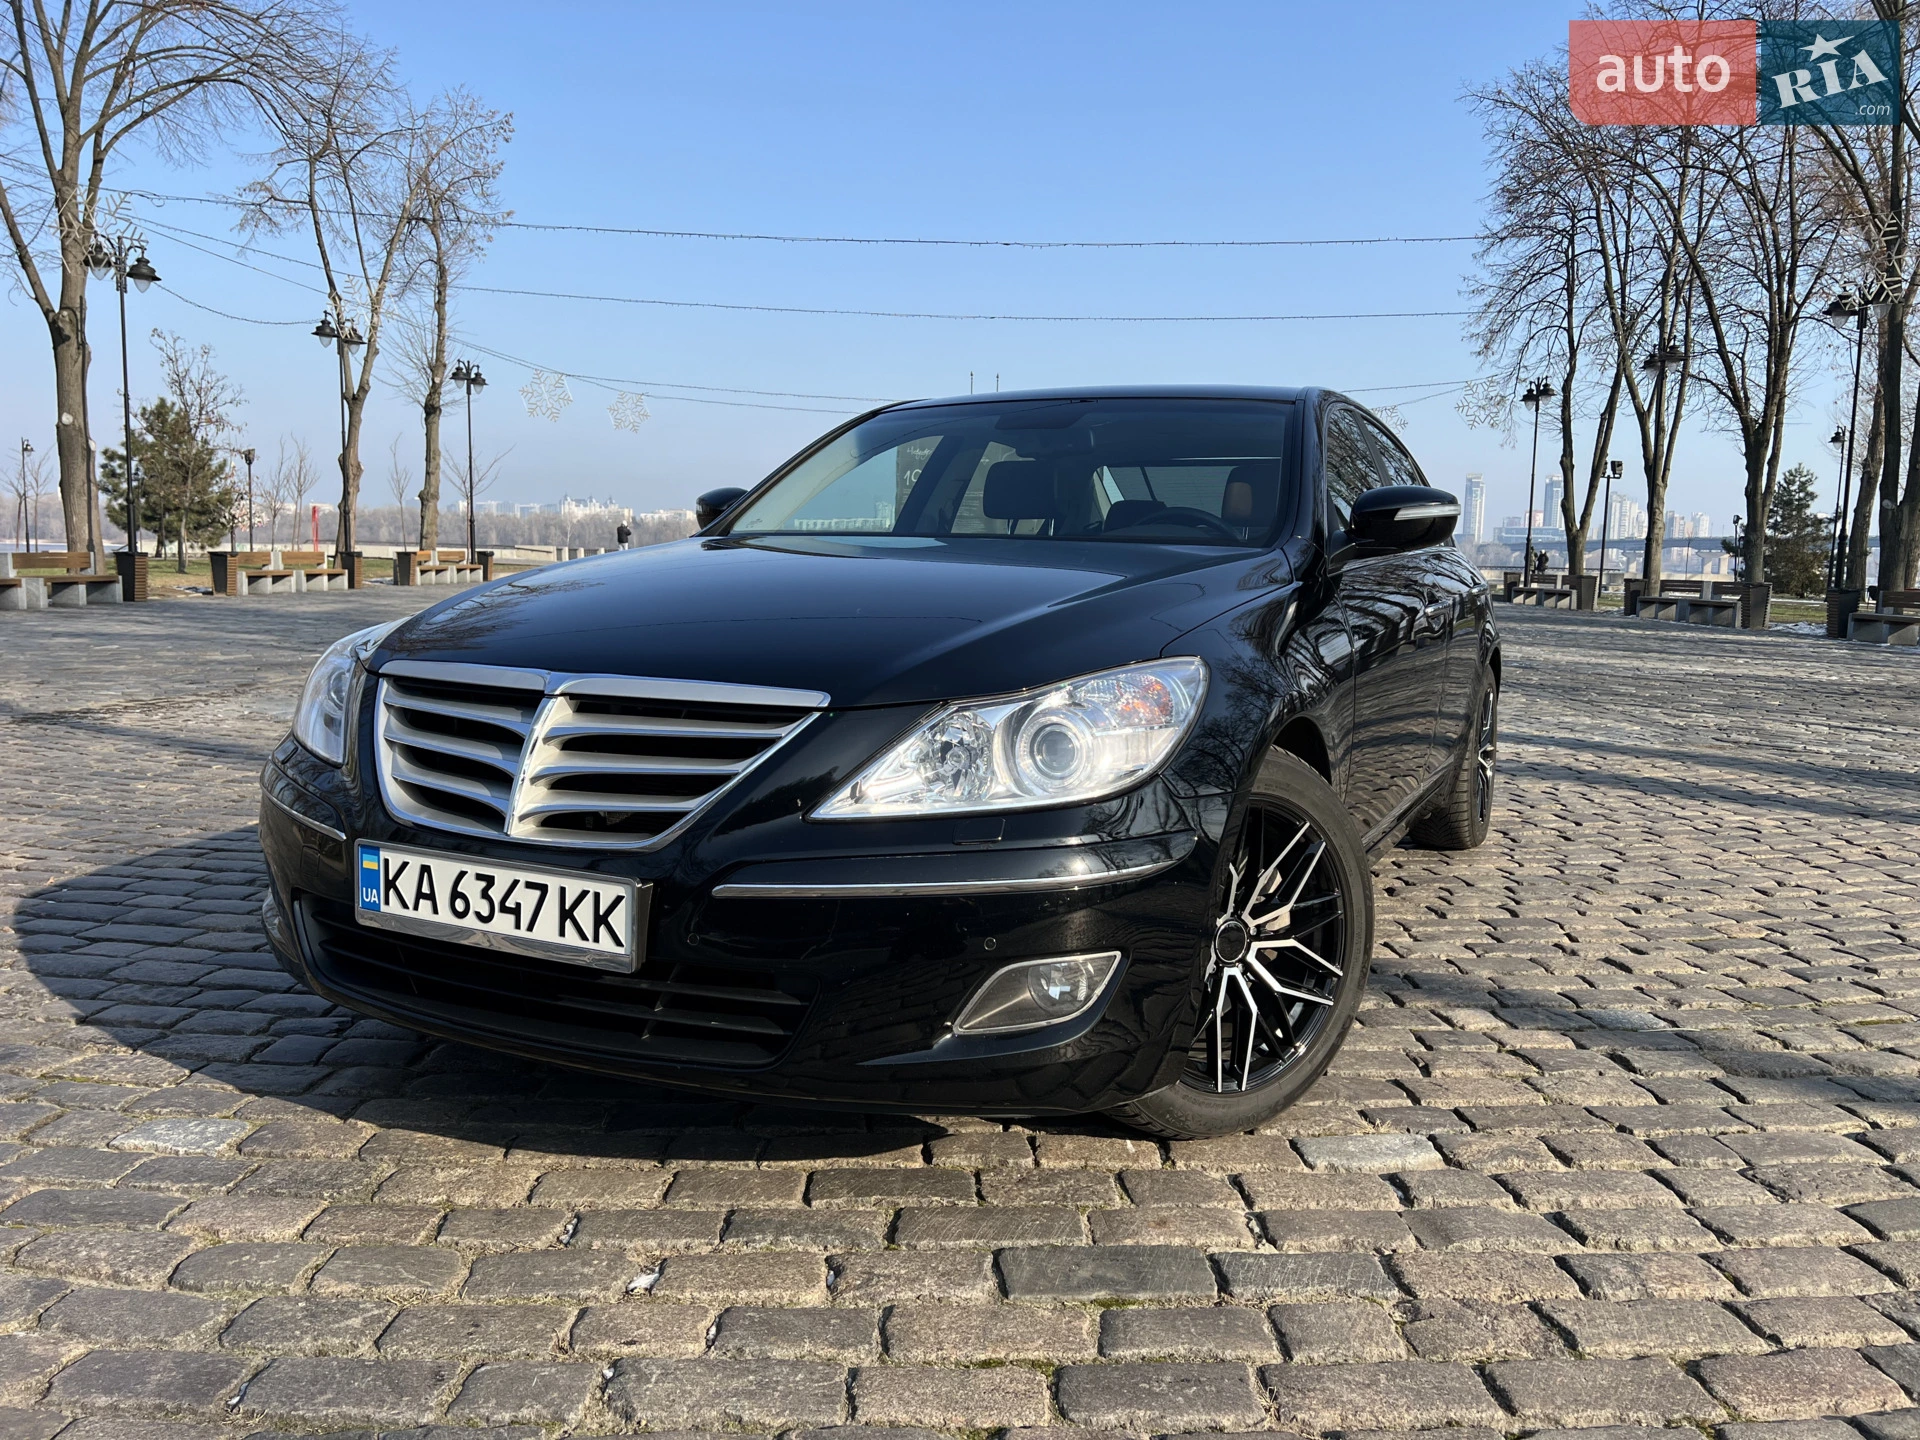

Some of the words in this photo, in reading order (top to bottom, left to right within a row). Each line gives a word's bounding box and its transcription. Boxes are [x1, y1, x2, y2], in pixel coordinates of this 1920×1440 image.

[362, 887, 379, 904] UA
[383, 856, 440, 915] KA
[450, 869, 549, 933] 6347
[558, 885, 626, 948] KK
